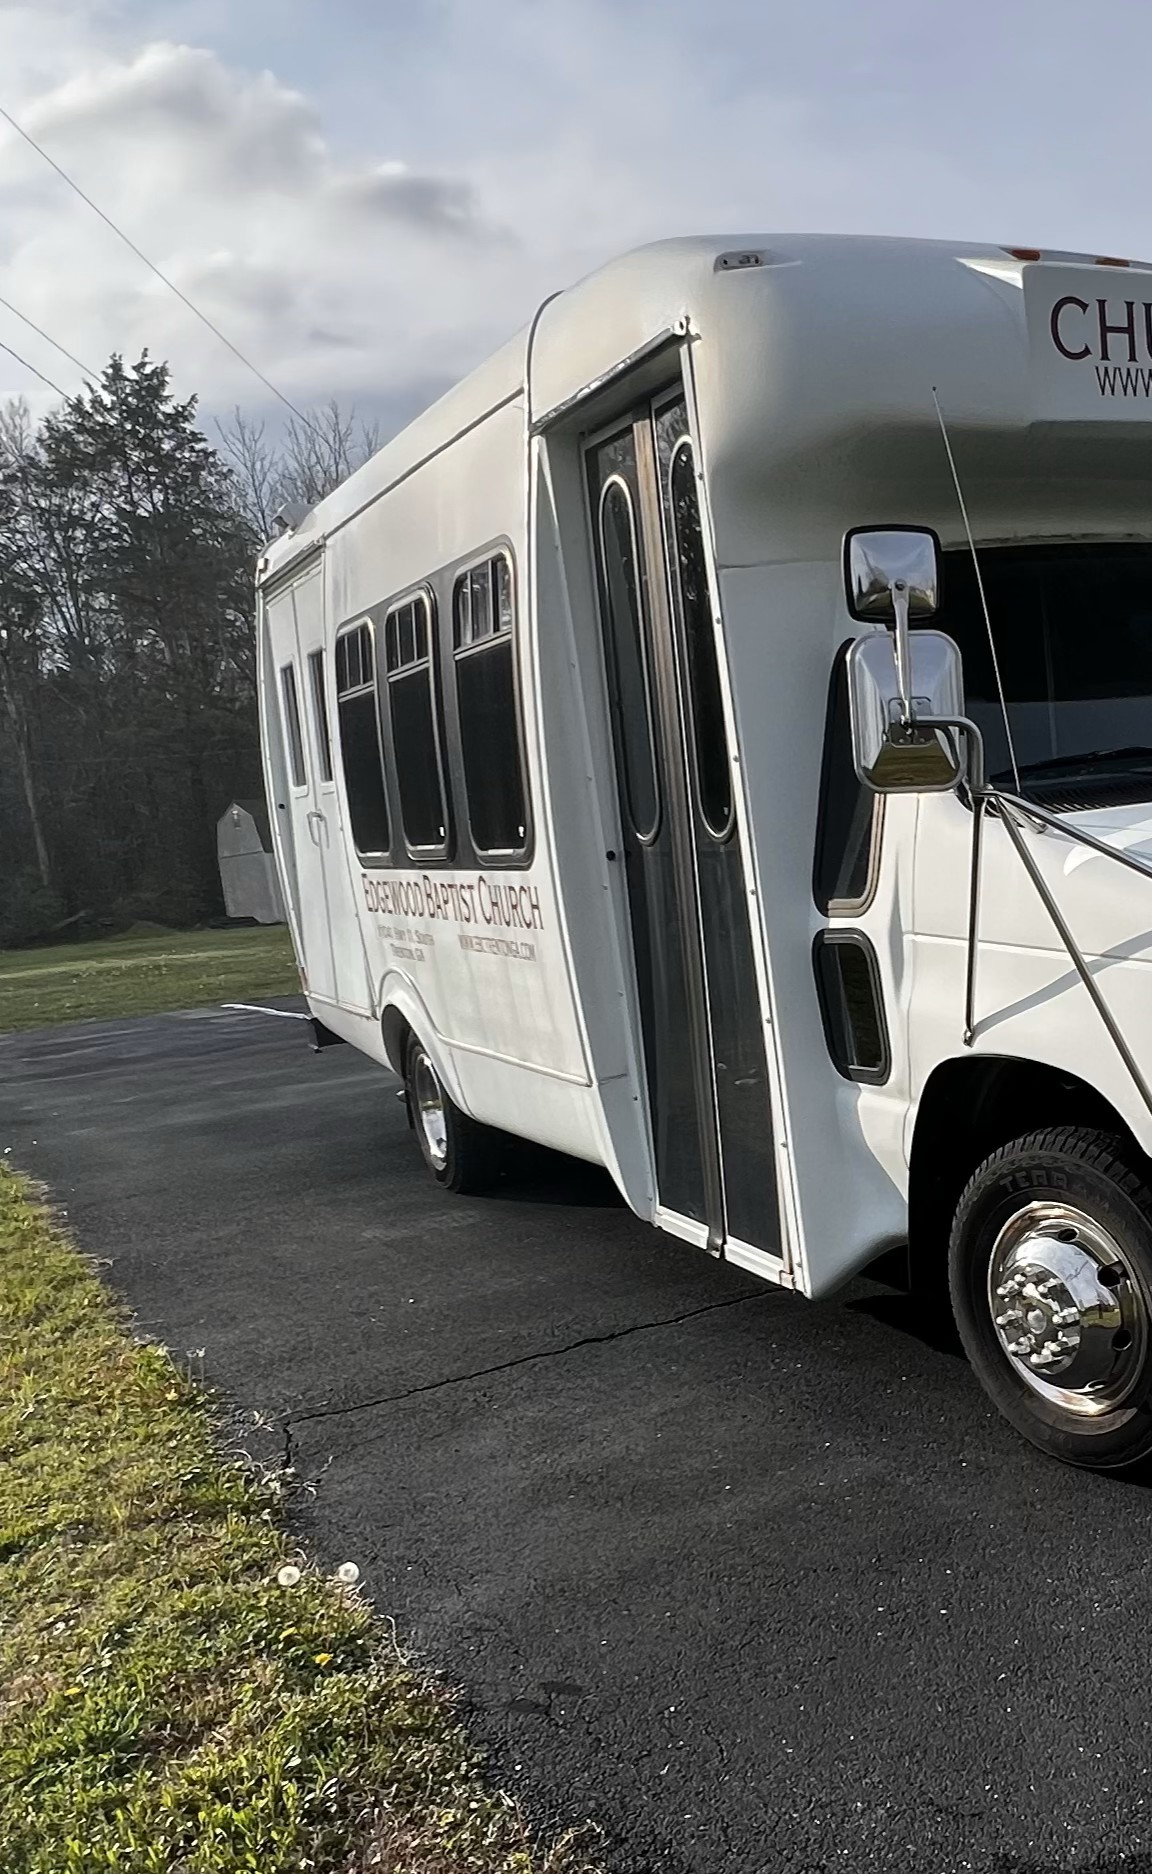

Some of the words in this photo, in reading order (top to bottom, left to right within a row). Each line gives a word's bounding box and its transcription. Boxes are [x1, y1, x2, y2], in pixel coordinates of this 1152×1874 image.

[361, 873, 425, 917] EDGEWOOD
[422, 875, 478, 924] BAPTIST
[478, 875, 544, 930] CHURCH
